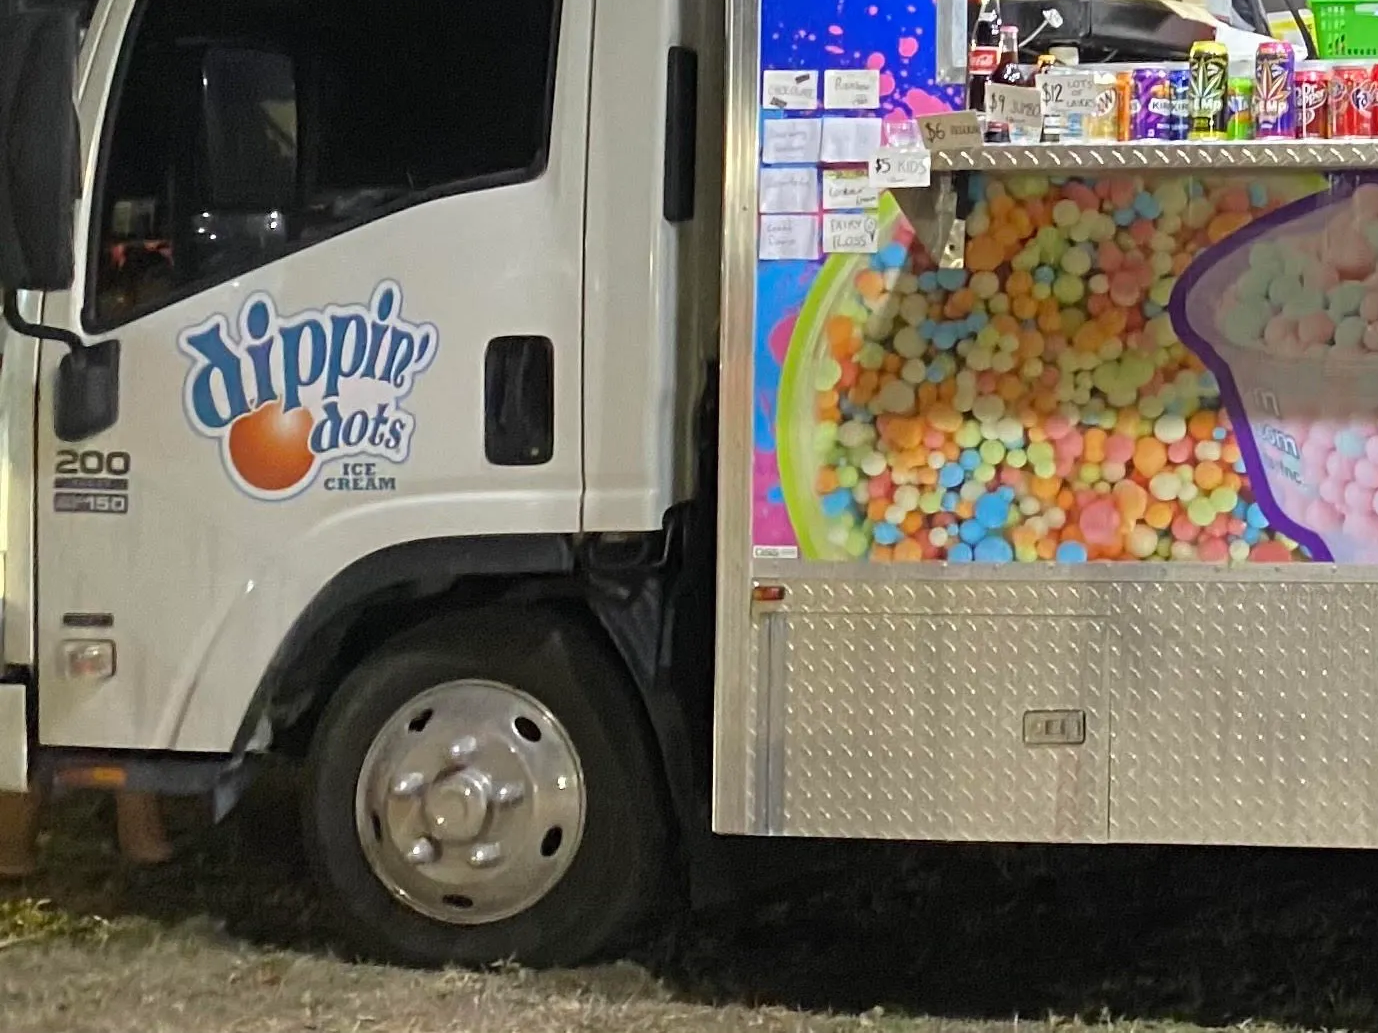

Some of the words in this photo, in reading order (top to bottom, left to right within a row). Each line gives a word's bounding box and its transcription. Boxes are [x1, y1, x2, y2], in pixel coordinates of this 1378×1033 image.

[924, 122, 946, 143] $6
[875, 158, 892, 174] $5
[897, 160, 927, 175] KIDS
[187, 288, 430, 428] dippin'
[310, 400, 406, 454] dots
[56, 449, 131, 475] 200
[342, 462, 377, 476] ICE
[324, 476, 396, 491] CREAM
